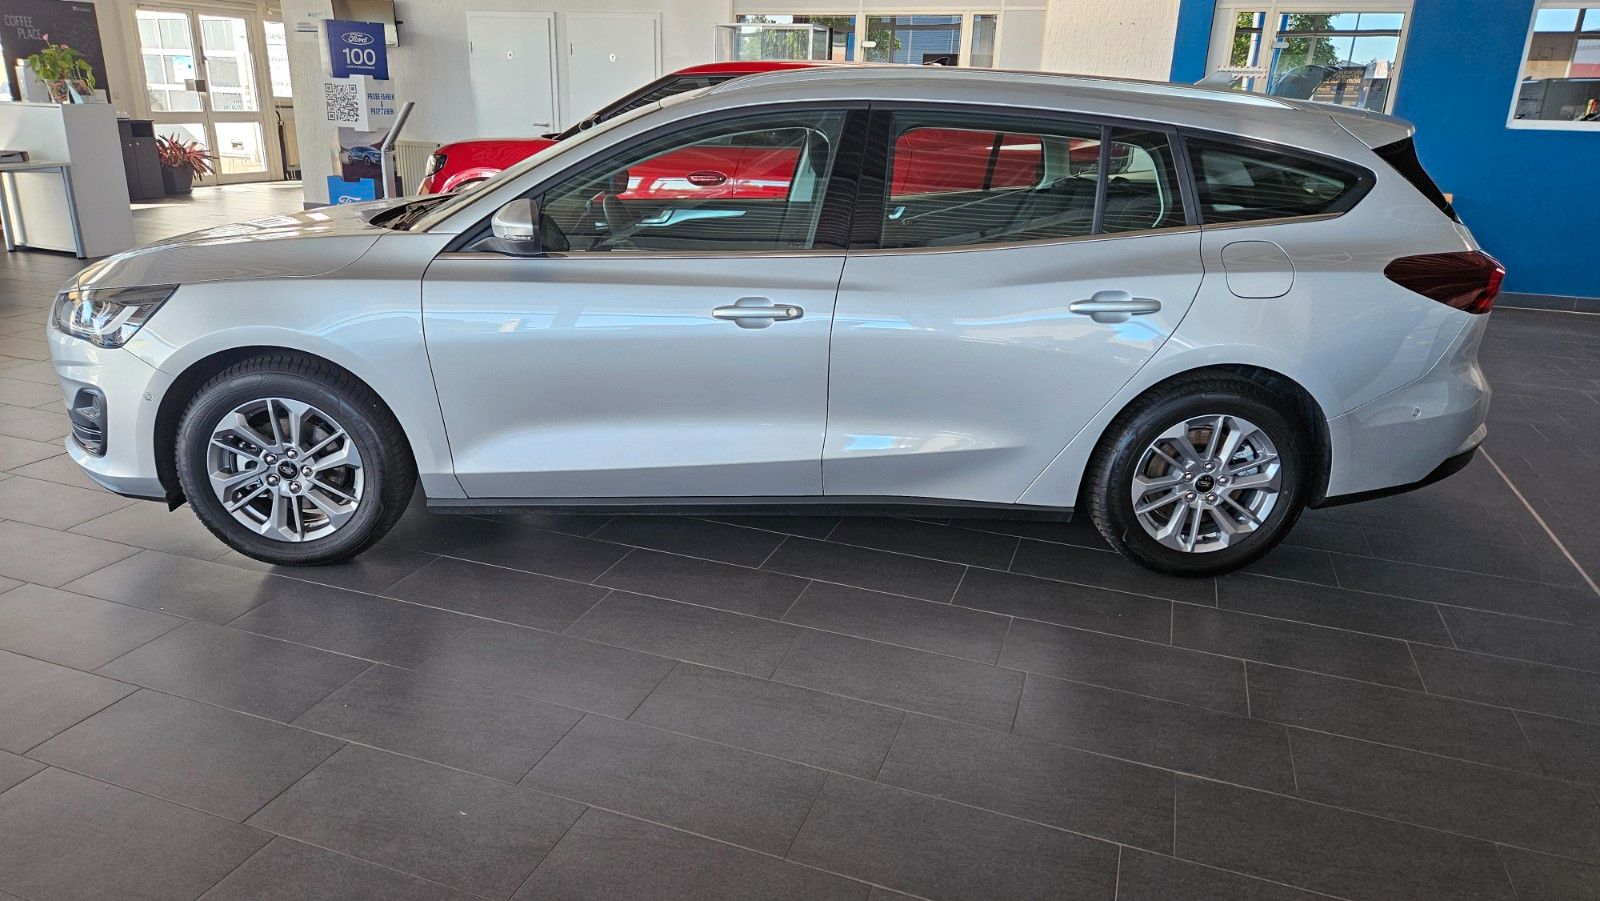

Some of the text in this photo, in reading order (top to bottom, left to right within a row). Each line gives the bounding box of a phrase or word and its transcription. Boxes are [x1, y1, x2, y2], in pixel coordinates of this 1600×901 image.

[4, 14, 34, 28] COFFEE
[17, 27, 42, 40] PLACE
[342, 47, 376, 66] 100
